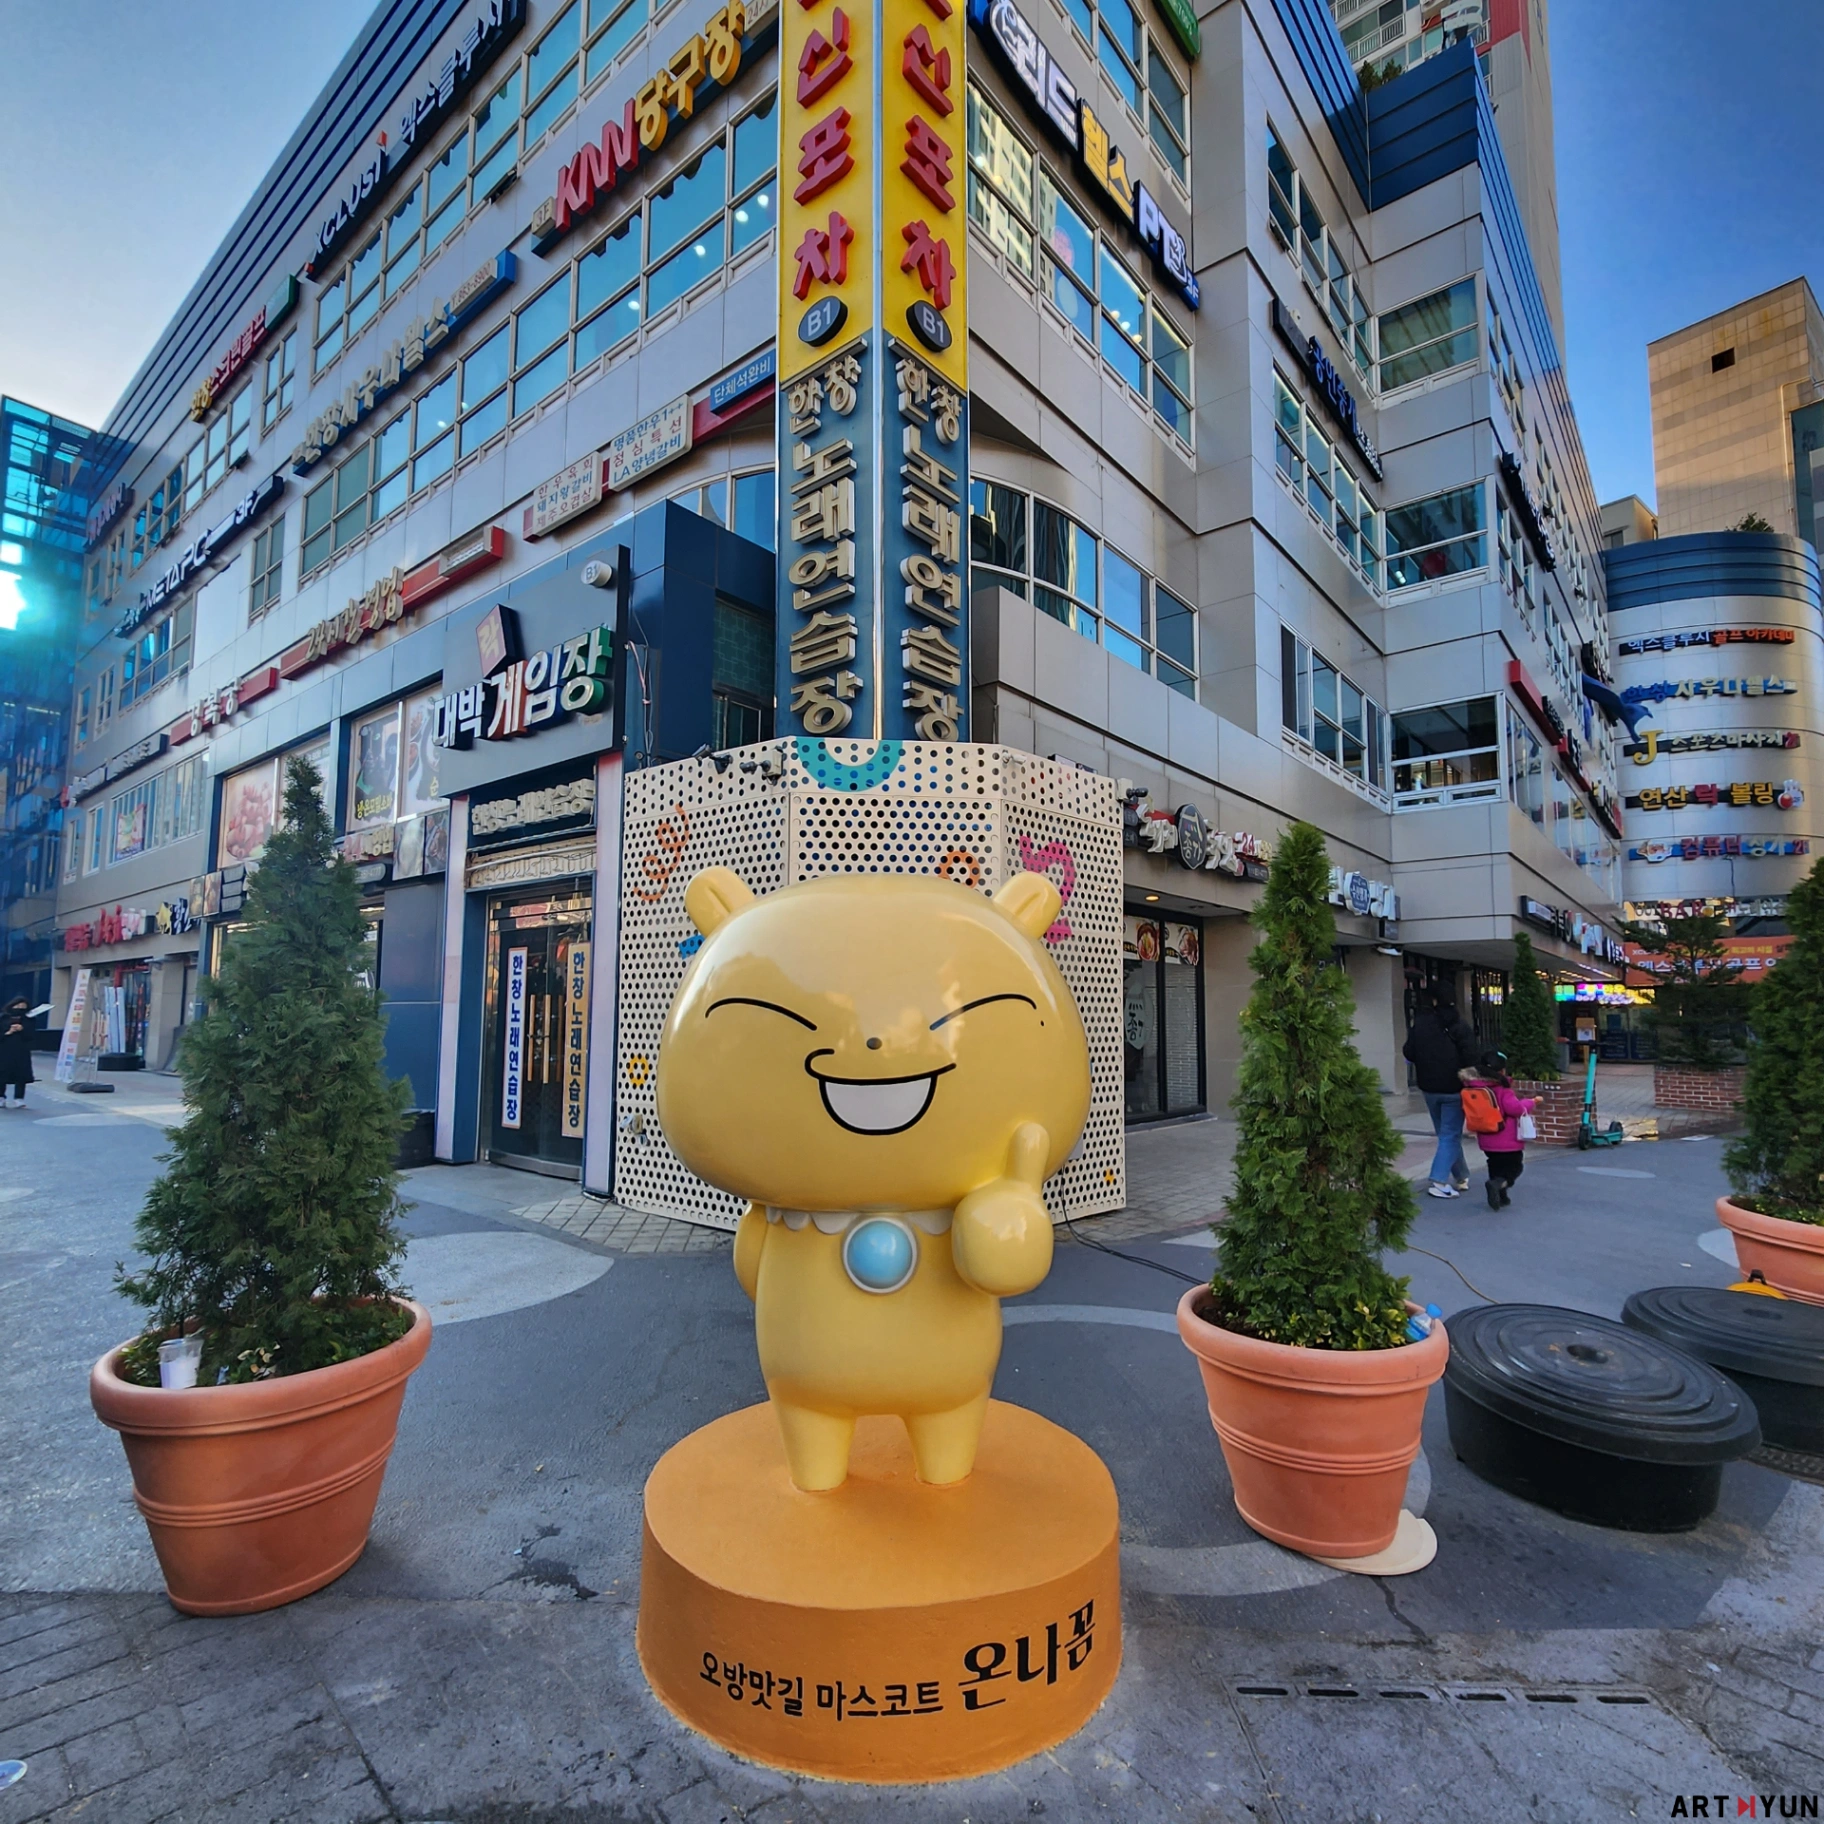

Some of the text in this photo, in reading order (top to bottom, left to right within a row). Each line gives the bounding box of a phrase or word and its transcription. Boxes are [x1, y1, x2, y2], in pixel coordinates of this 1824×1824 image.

[807, 307, 832, 337] B1
[922, 313, 946, 344] B1
[713, 356, 772, 404] 단체석완비
[1639, 785, 1690, 811] 연산
[1730, 781, 1774, 805] 볼링
[1681, 834, 1743, 861] 컴퓨터
[1747, 834, 1788, 857] 상가
[699, 1651, 804, 1717] 오방맛길
[816, 1680, 943, 1722] 마스코트
